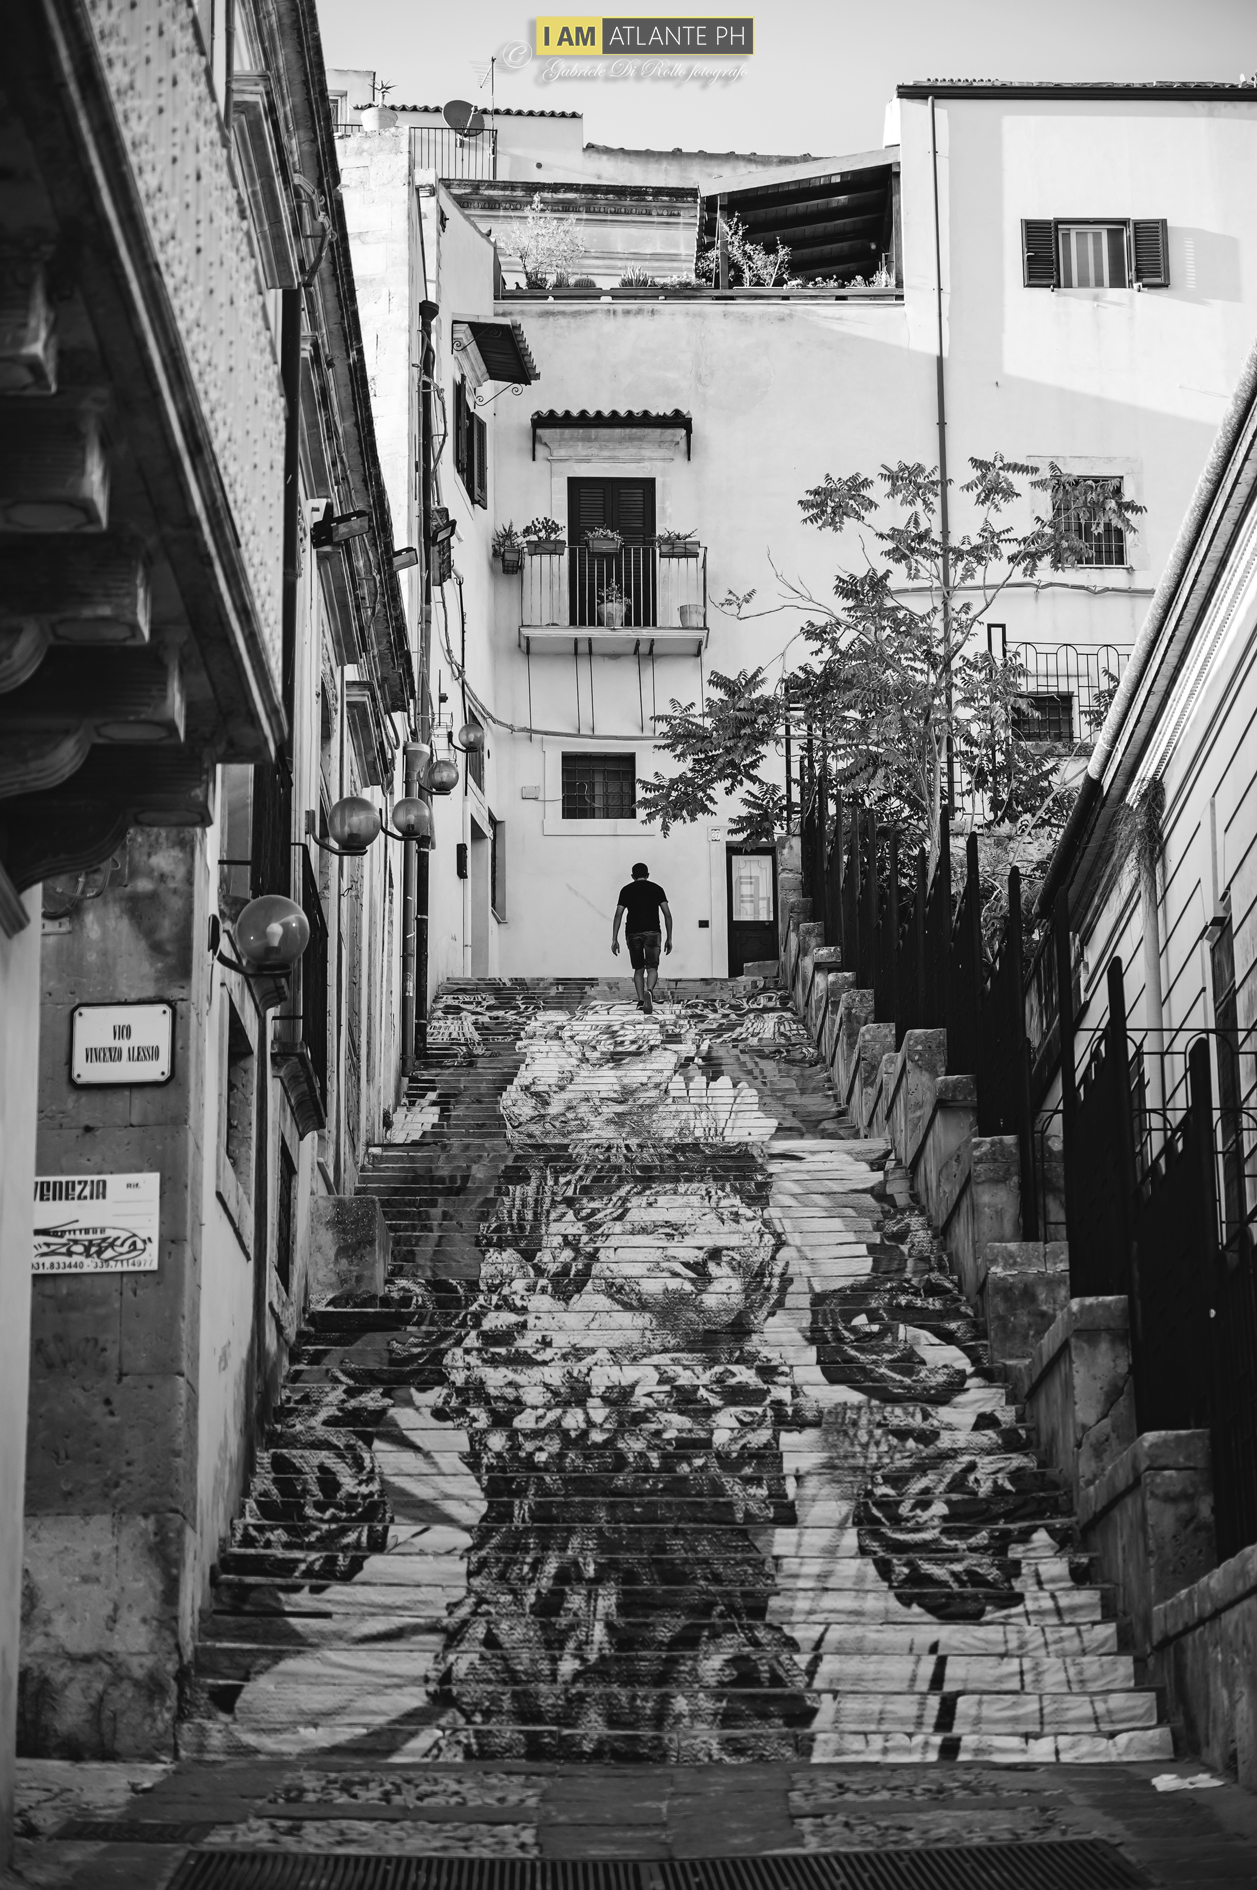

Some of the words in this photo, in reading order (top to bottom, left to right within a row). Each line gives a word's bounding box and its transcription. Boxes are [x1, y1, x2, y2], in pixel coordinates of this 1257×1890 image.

[113, 1024, 131, 1040] VICO
[85, 1046, 122, 1063] VINCENZO
[126, 1045, 160, 1062] ALESSIO
